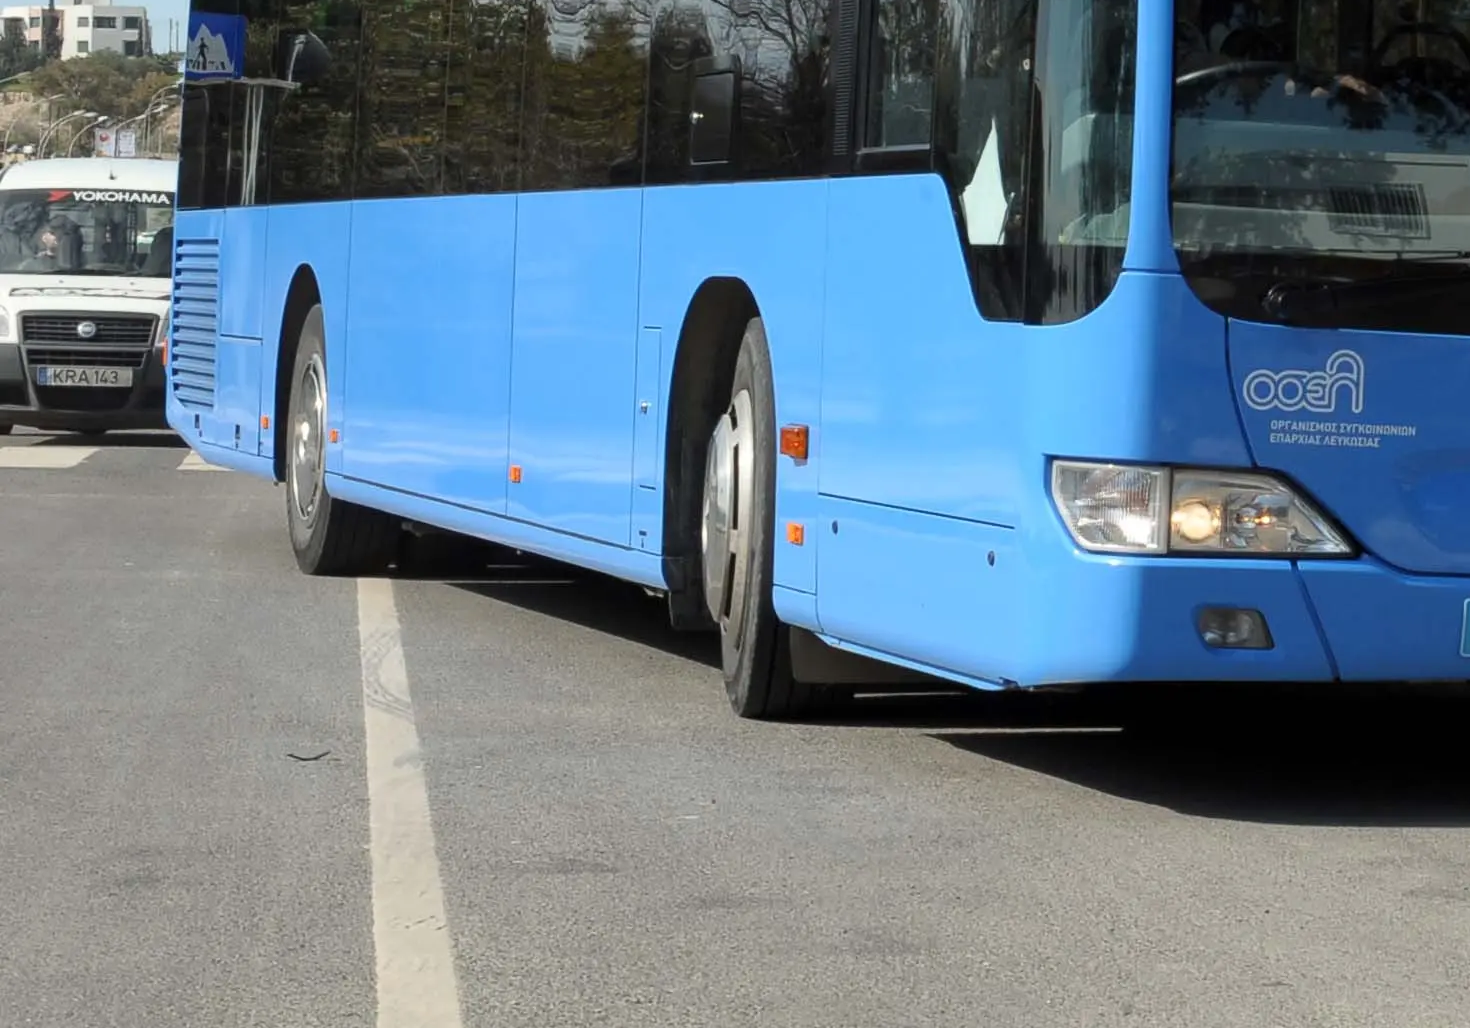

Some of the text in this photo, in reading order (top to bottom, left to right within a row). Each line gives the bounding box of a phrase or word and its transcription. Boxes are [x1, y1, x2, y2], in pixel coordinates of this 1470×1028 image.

[72, 190, 170, 205] YOKOHAMA
[53, 369, 119, 384] KRA 143
[1270, 420, 1416, 436] ΟΡΓΑΝΙΣΜΟΣ ΣΥΓΚΟΙΝΩΝΙΩΝ
[1270, 432, 1381, 448] ΕΠΑΡΧΙΑΣ ΛΕΥΚΩΣΙΑΣ
